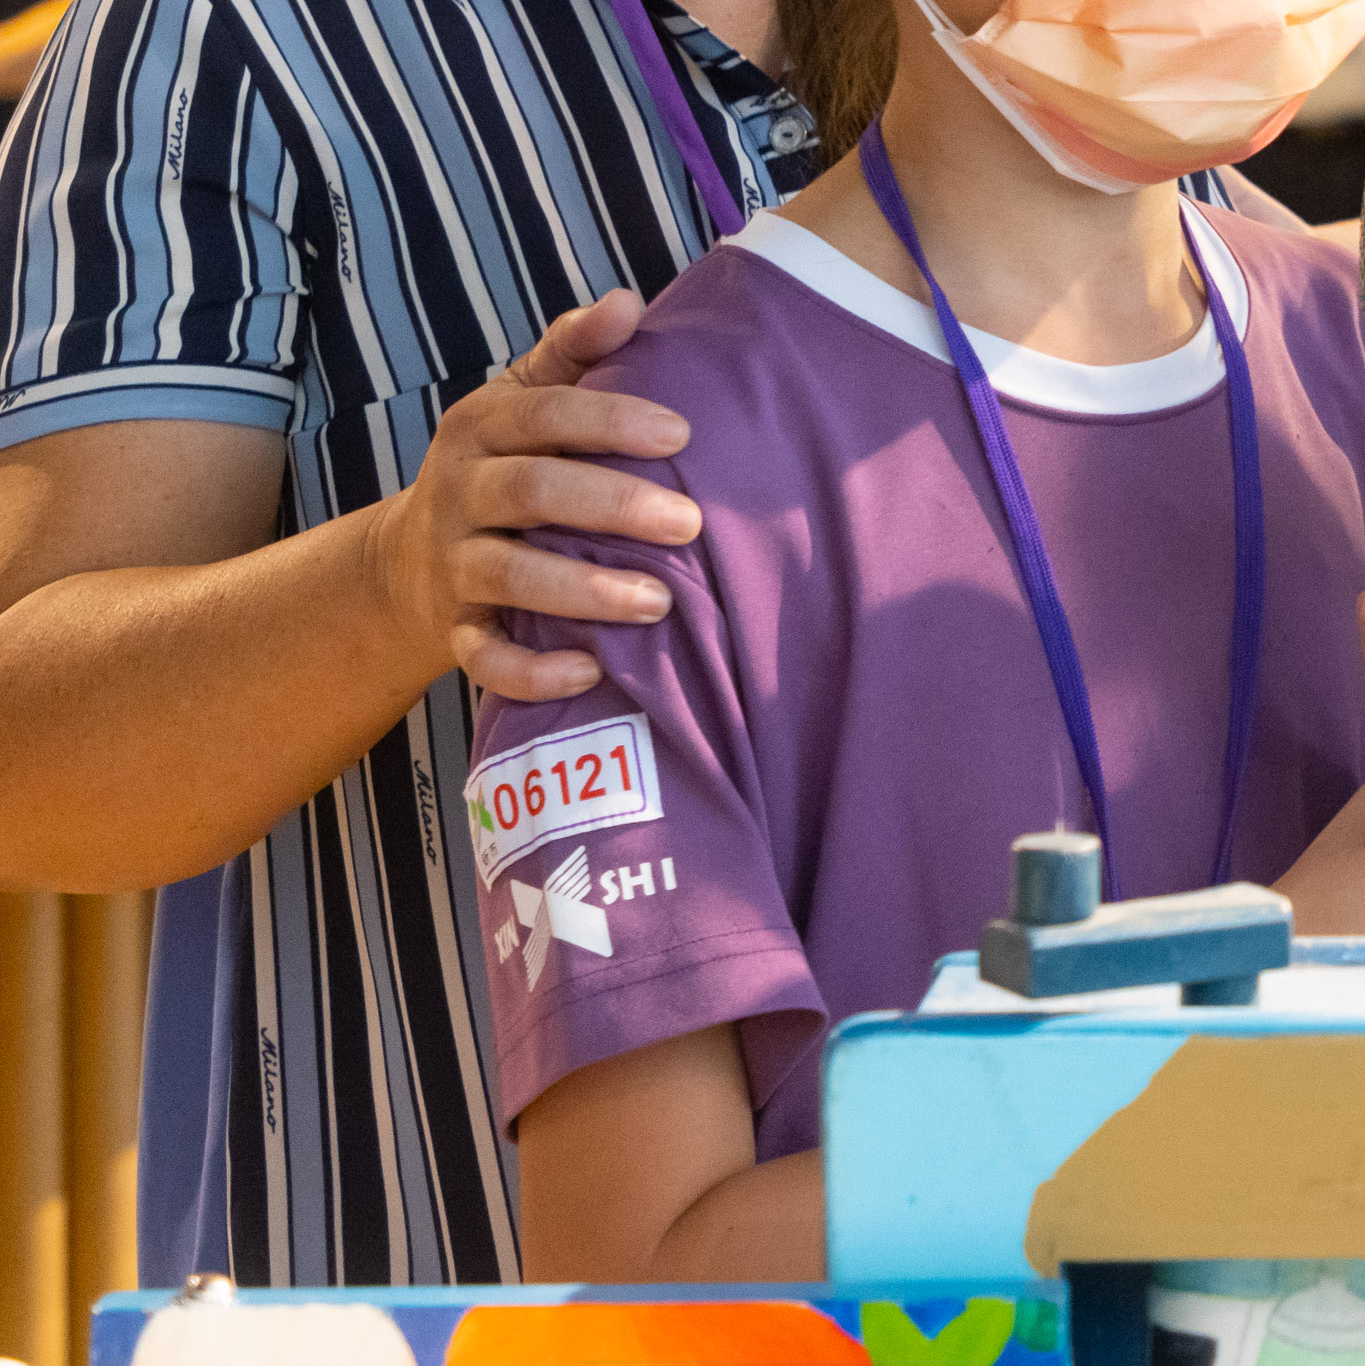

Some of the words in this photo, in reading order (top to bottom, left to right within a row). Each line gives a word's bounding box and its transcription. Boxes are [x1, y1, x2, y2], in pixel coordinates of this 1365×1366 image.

[168, 87, 188, 181] Milano
[327, 181, 352, 284] Milano
[414, 759, 438, 866] Milano
[493, 744, 632, 831] 06121
[599, 857, 677, 905] SHI
[260, 1026, 276, 1134] Milano
